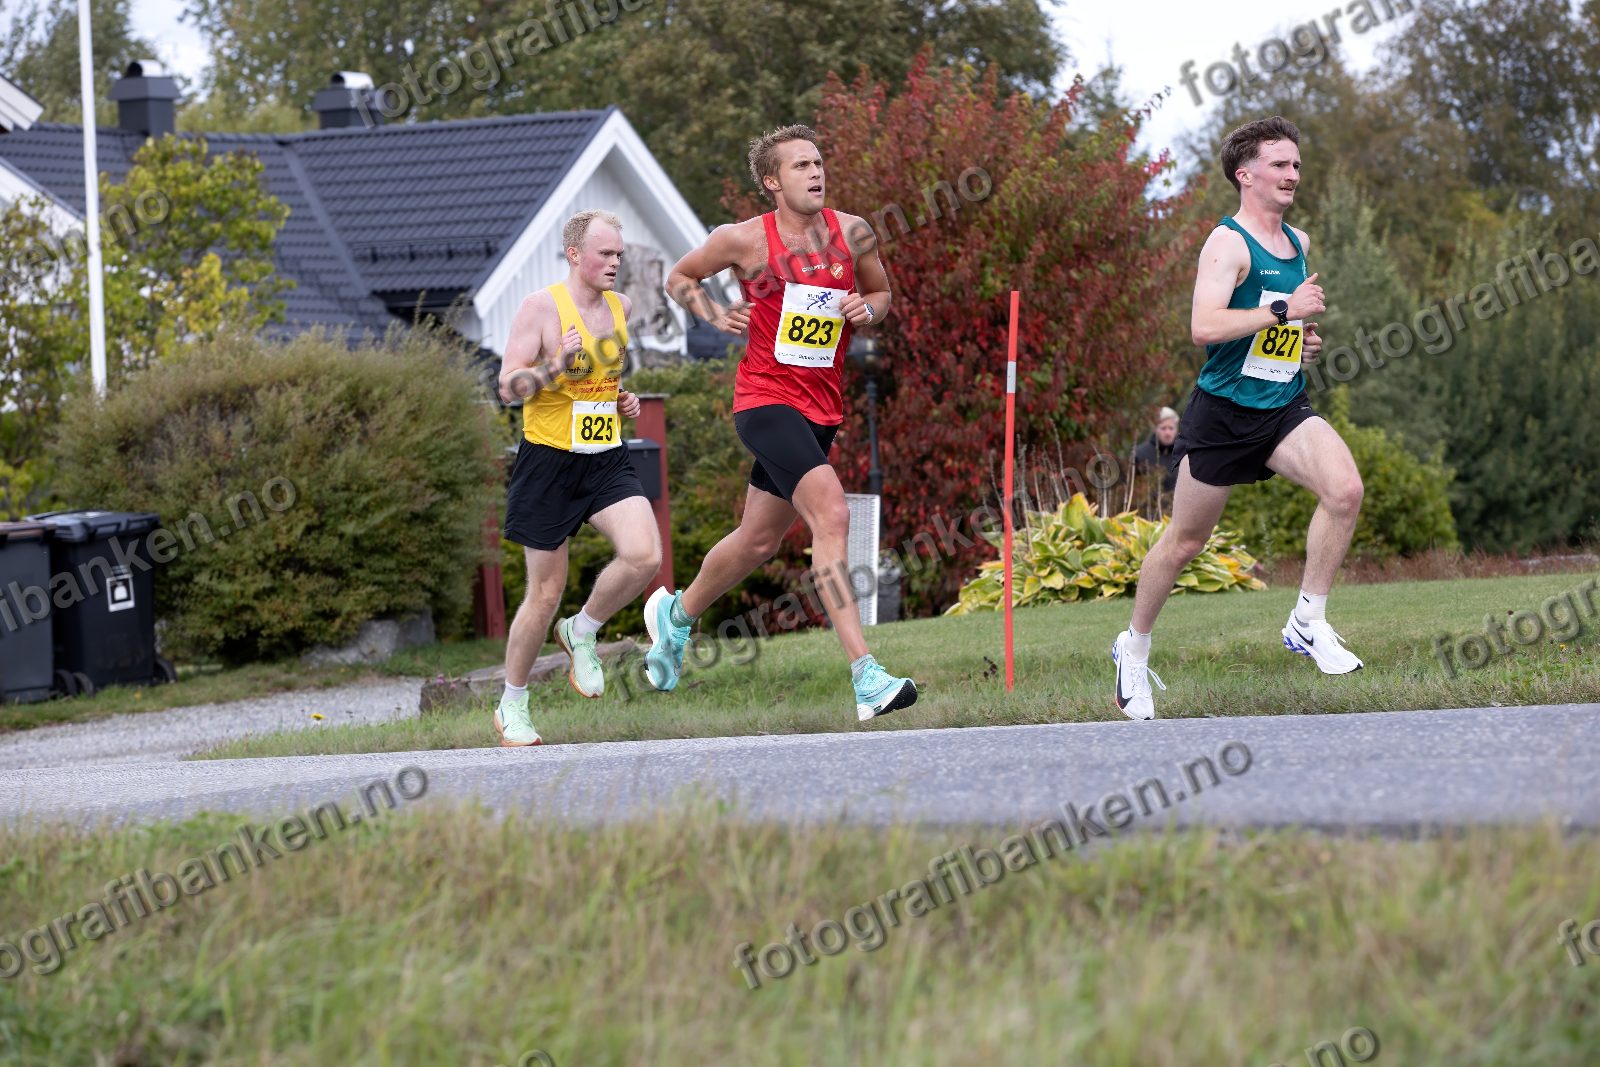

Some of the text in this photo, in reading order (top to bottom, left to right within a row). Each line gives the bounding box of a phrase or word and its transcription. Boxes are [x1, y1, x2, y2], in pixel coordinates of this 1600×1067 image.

[788, 315, 834, 345] 823
[1261, 326, 1301, 358] 827
[580, 416, 613, 441] 825
